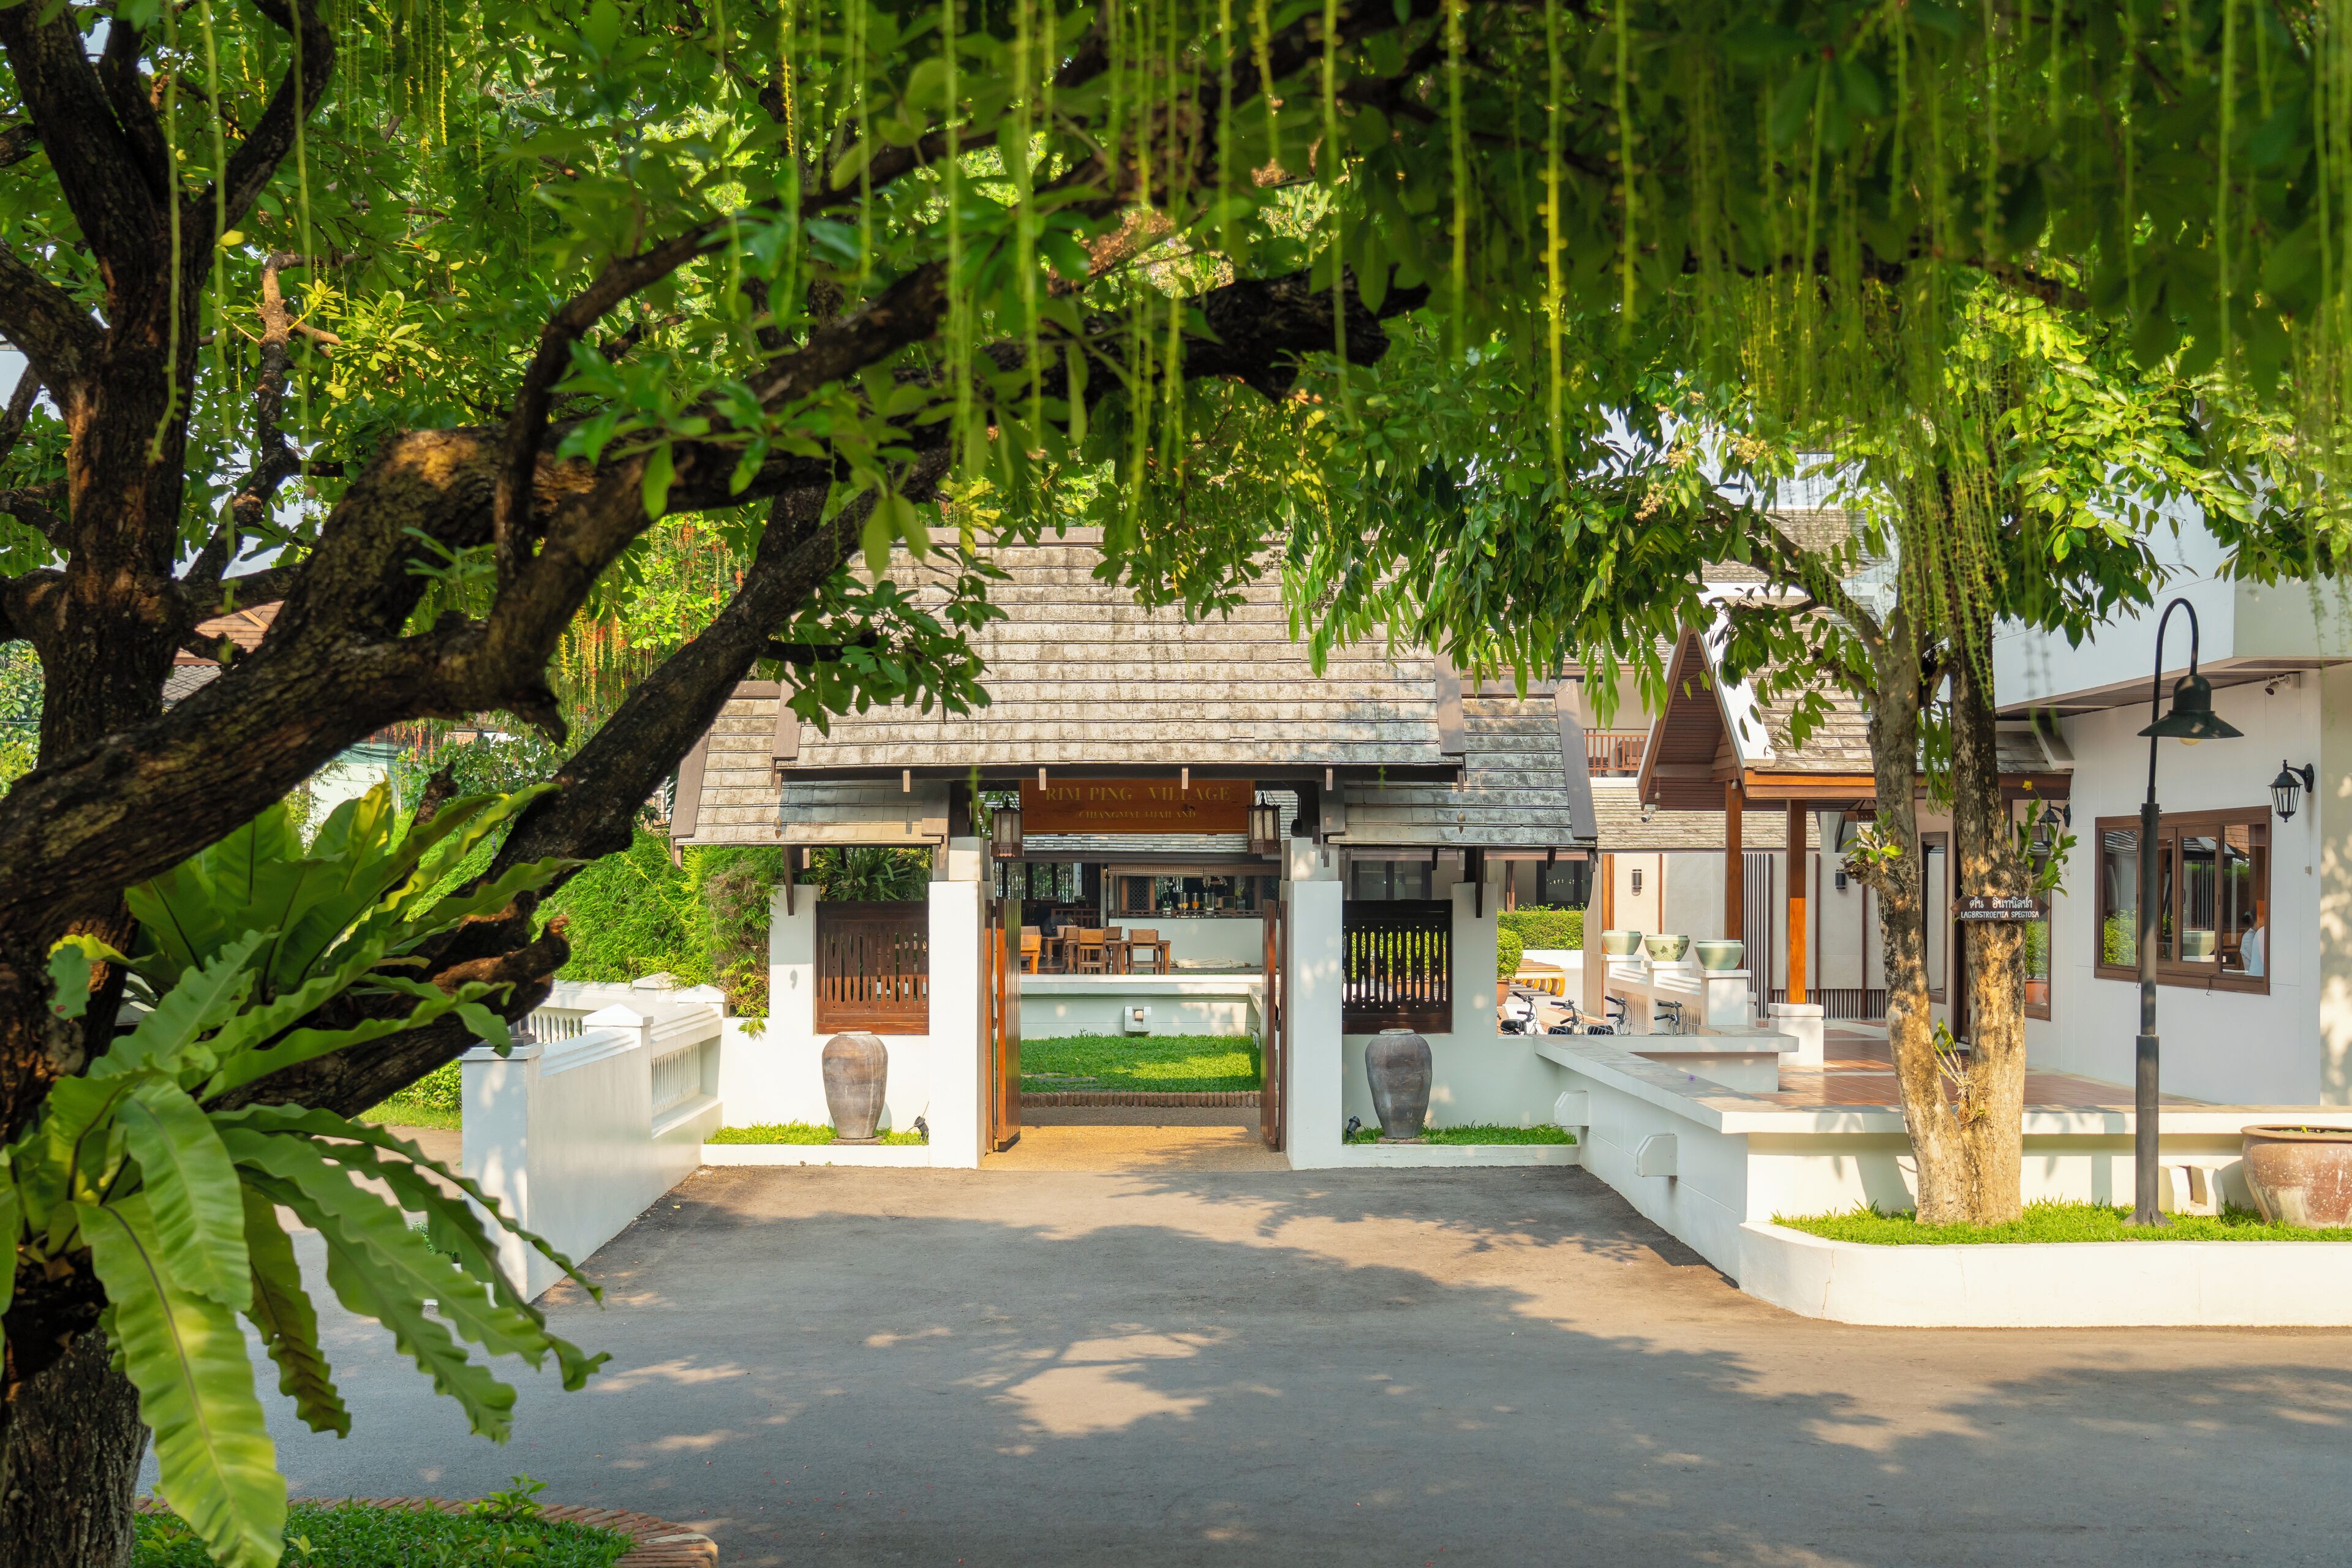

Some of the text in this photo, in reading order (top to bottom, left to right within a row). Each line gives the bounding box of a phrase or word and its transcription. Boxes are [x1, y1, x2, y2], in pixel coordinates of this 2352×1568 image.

[1046, 787, 1231, 801] RIM PING VILLAGE
[1145, 810, 1196, 819] THAILAND
